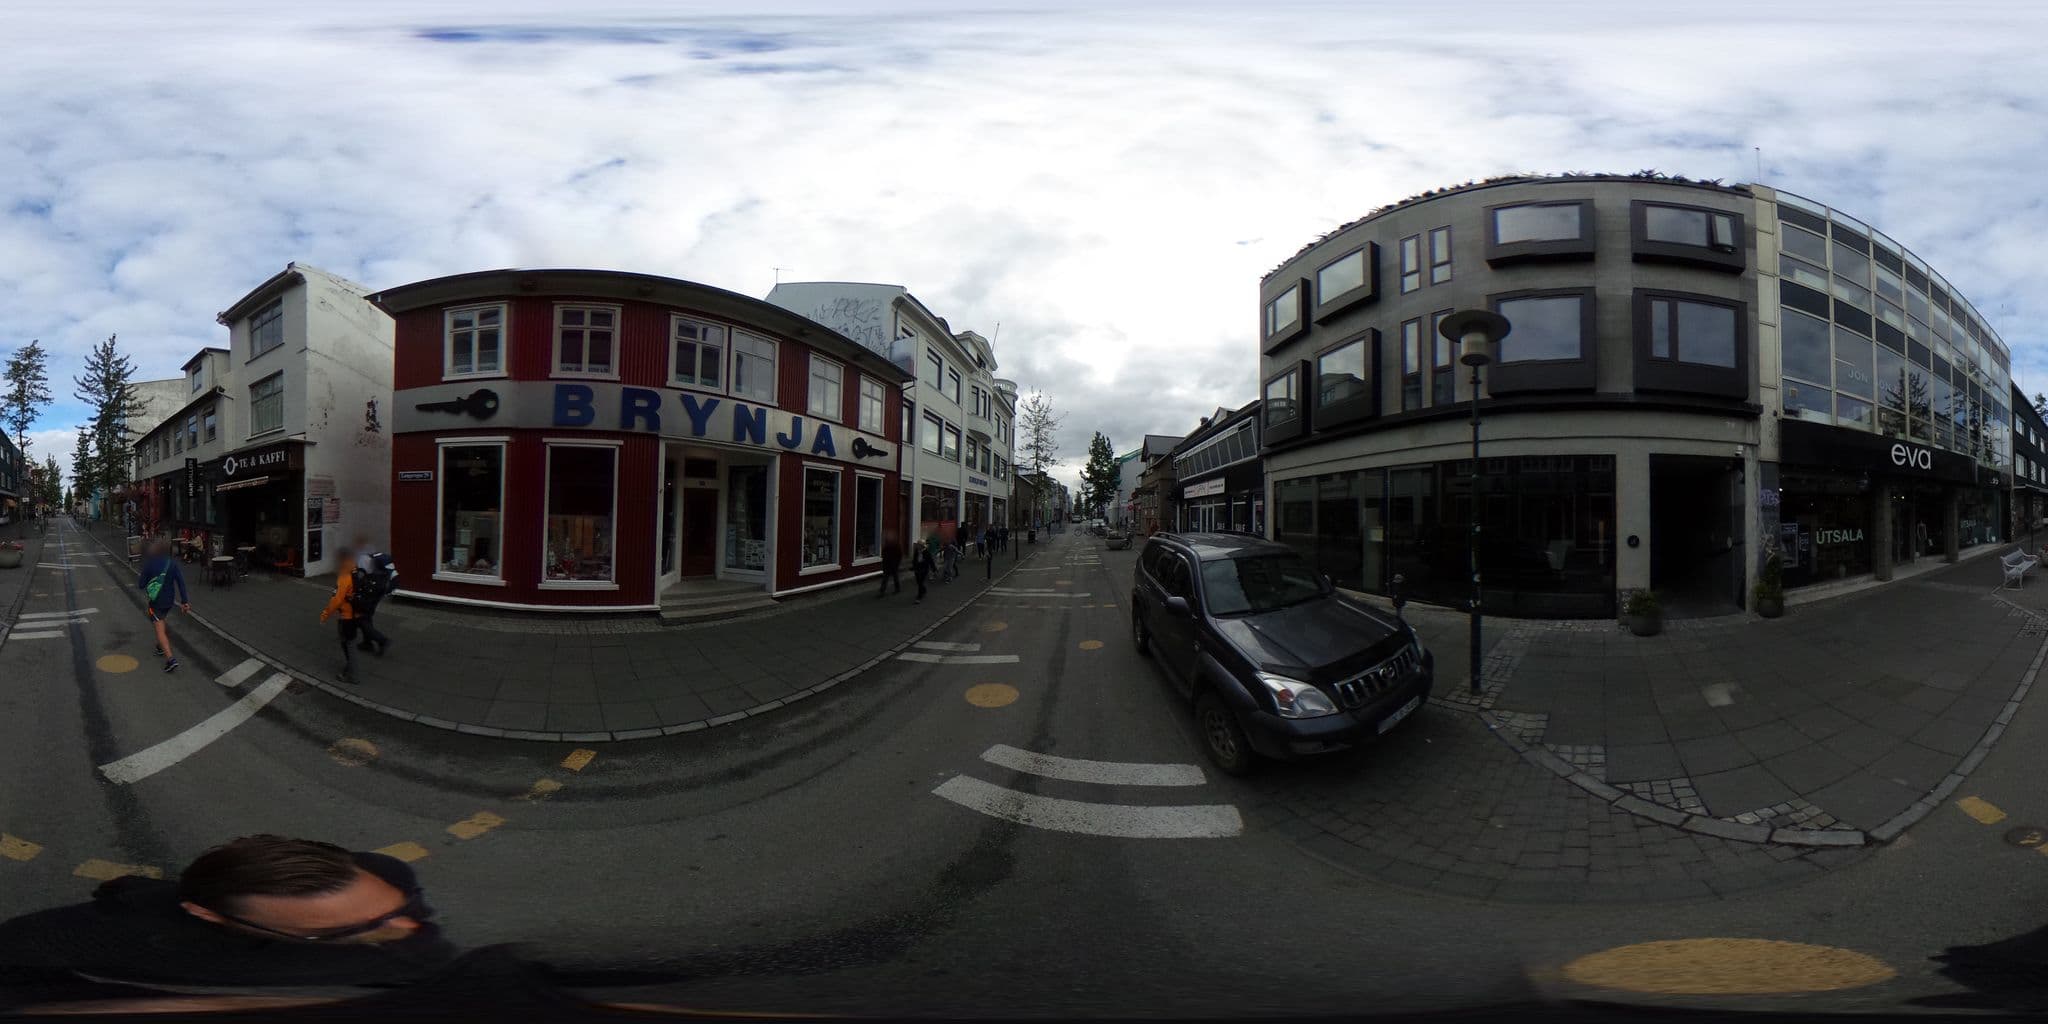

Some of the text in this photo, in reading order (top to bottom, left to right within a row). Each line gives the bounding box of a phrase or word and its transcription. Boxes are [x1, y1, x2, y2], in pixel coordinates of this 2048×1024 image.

[554, 384, 836, 457] BRYNJA
[239, 450, 286, 469] TE & KAFFI
[1891, 443, 1932, 470] eva
[1816, 527, 1864, 545] ÚTSALA
